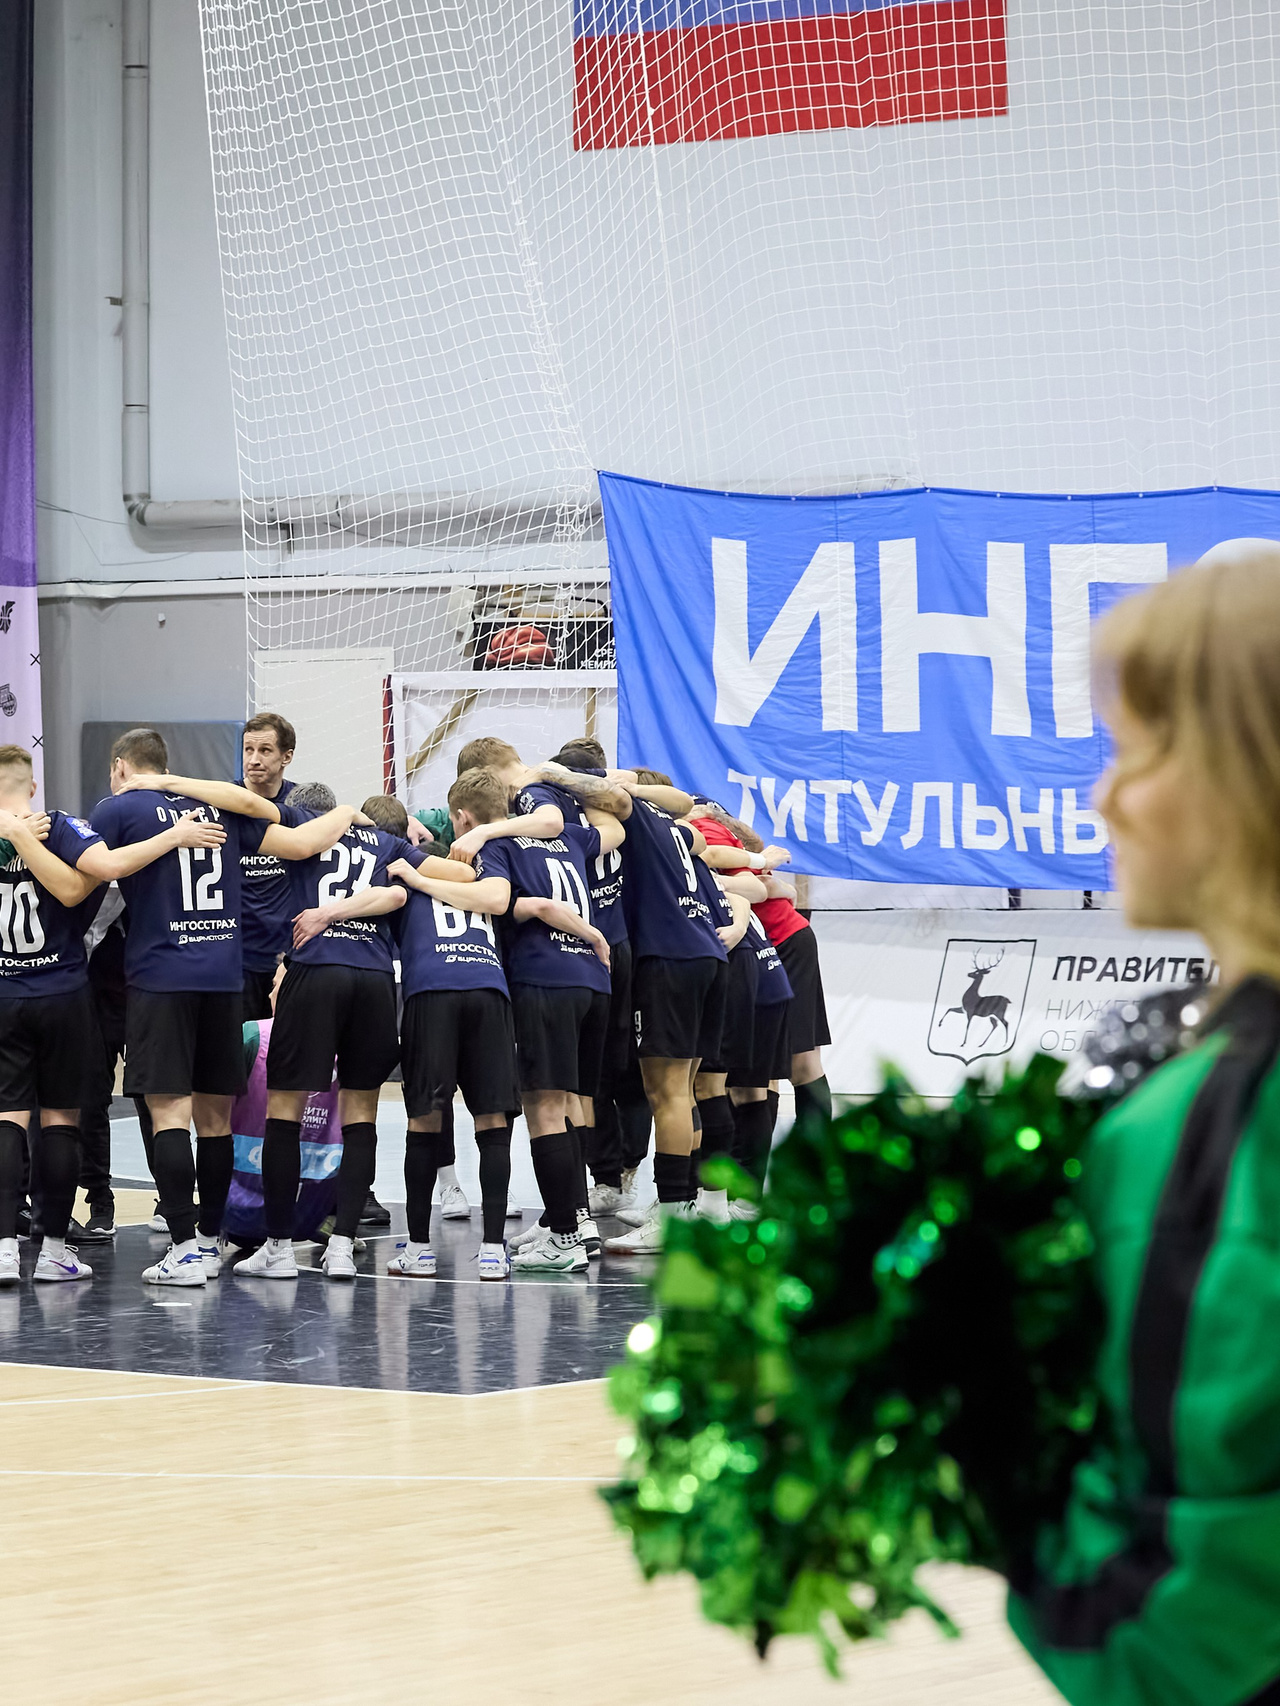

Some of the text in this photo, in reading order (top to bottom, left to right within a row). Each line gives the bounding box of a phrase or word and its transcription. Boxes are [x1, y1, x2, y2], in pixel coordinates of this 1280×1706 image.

[711, 537, 1280, 738] ИНГ
[177, 846, 224, 912] 12
[245, 868, 286, 877] NORMAN
[670, 827, 698, 893] 9
[170, 918, 237, 931] ИНГОССТРАХ
[634, 1010, 642, 1033] 9
